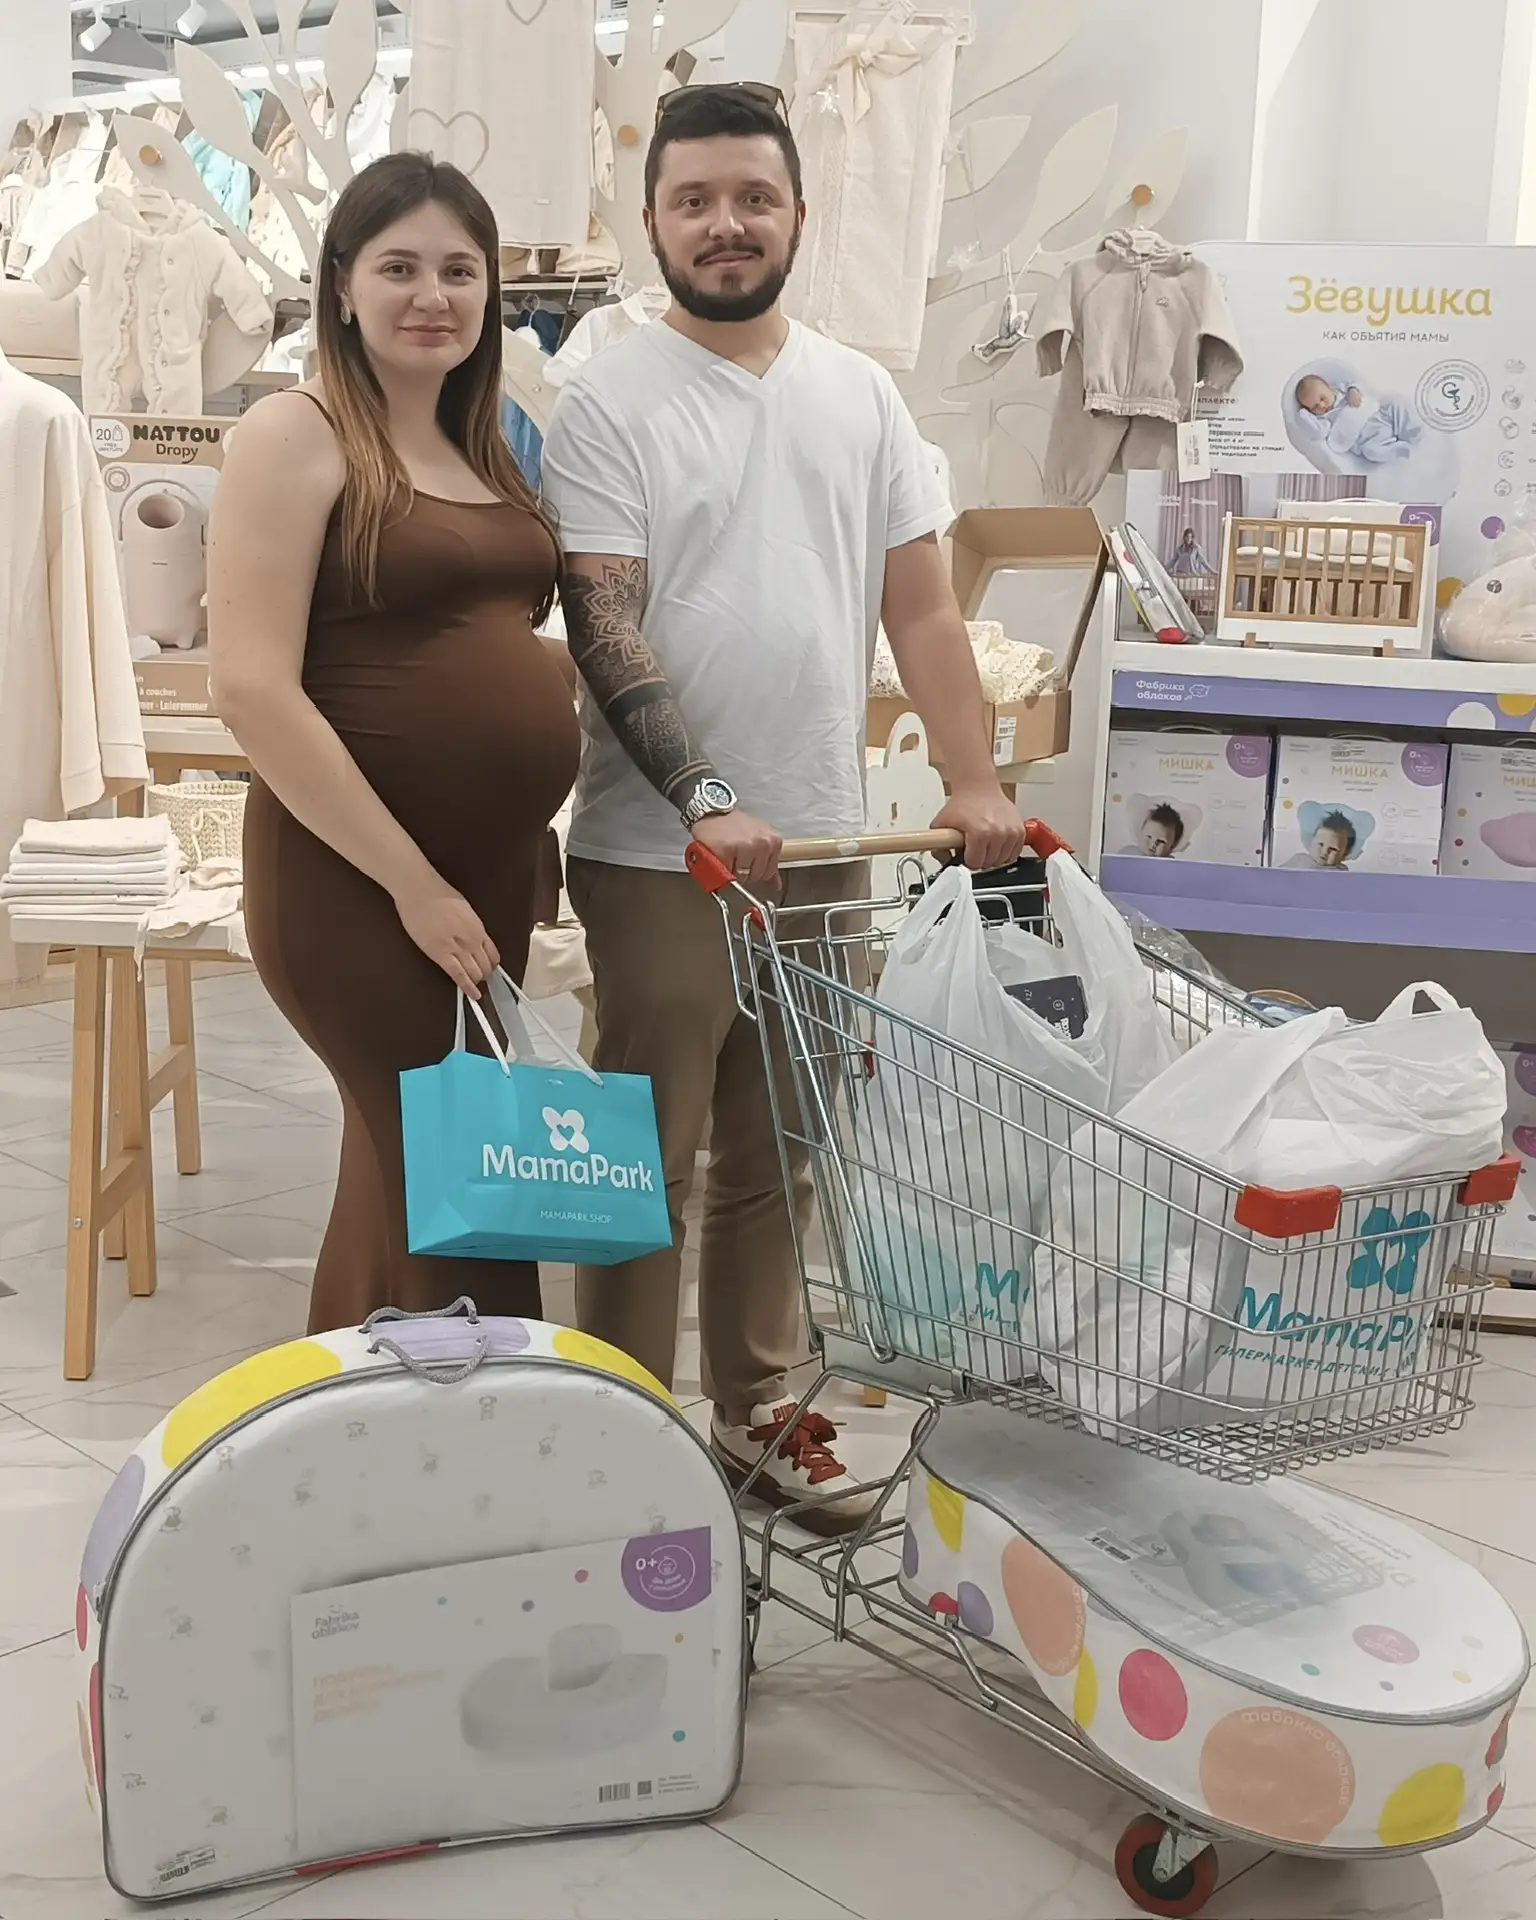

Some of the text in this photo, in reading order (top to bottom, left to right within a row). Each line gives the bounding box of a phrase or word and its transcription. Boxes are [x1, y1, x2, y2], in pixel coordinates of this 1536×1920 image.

[1286, 275, 1492, 327] Зёвушка
[1322, 331, 1450, 343] КАК ОБЪЯТИЯ МАМЫ
[96, 428, 111, 441] 20
[133, 425, 220, 443] NATTOU
[156, 443, 199, 464] Dropy
[1136, 680, 1185, 692] Фабрика
[1137, 691, 1182, 701] облаков
[1159, 757, 1215, 771] МИШКА
[1331, 765, 1389, 779] МИШКА
[482, 1143, 654, 1192] MamaPark
[976, 1262, 1030, 1305] M
[1236, 1287, 1416, 1352] MamaP
[635, 1557, 657, 1571] 0+
